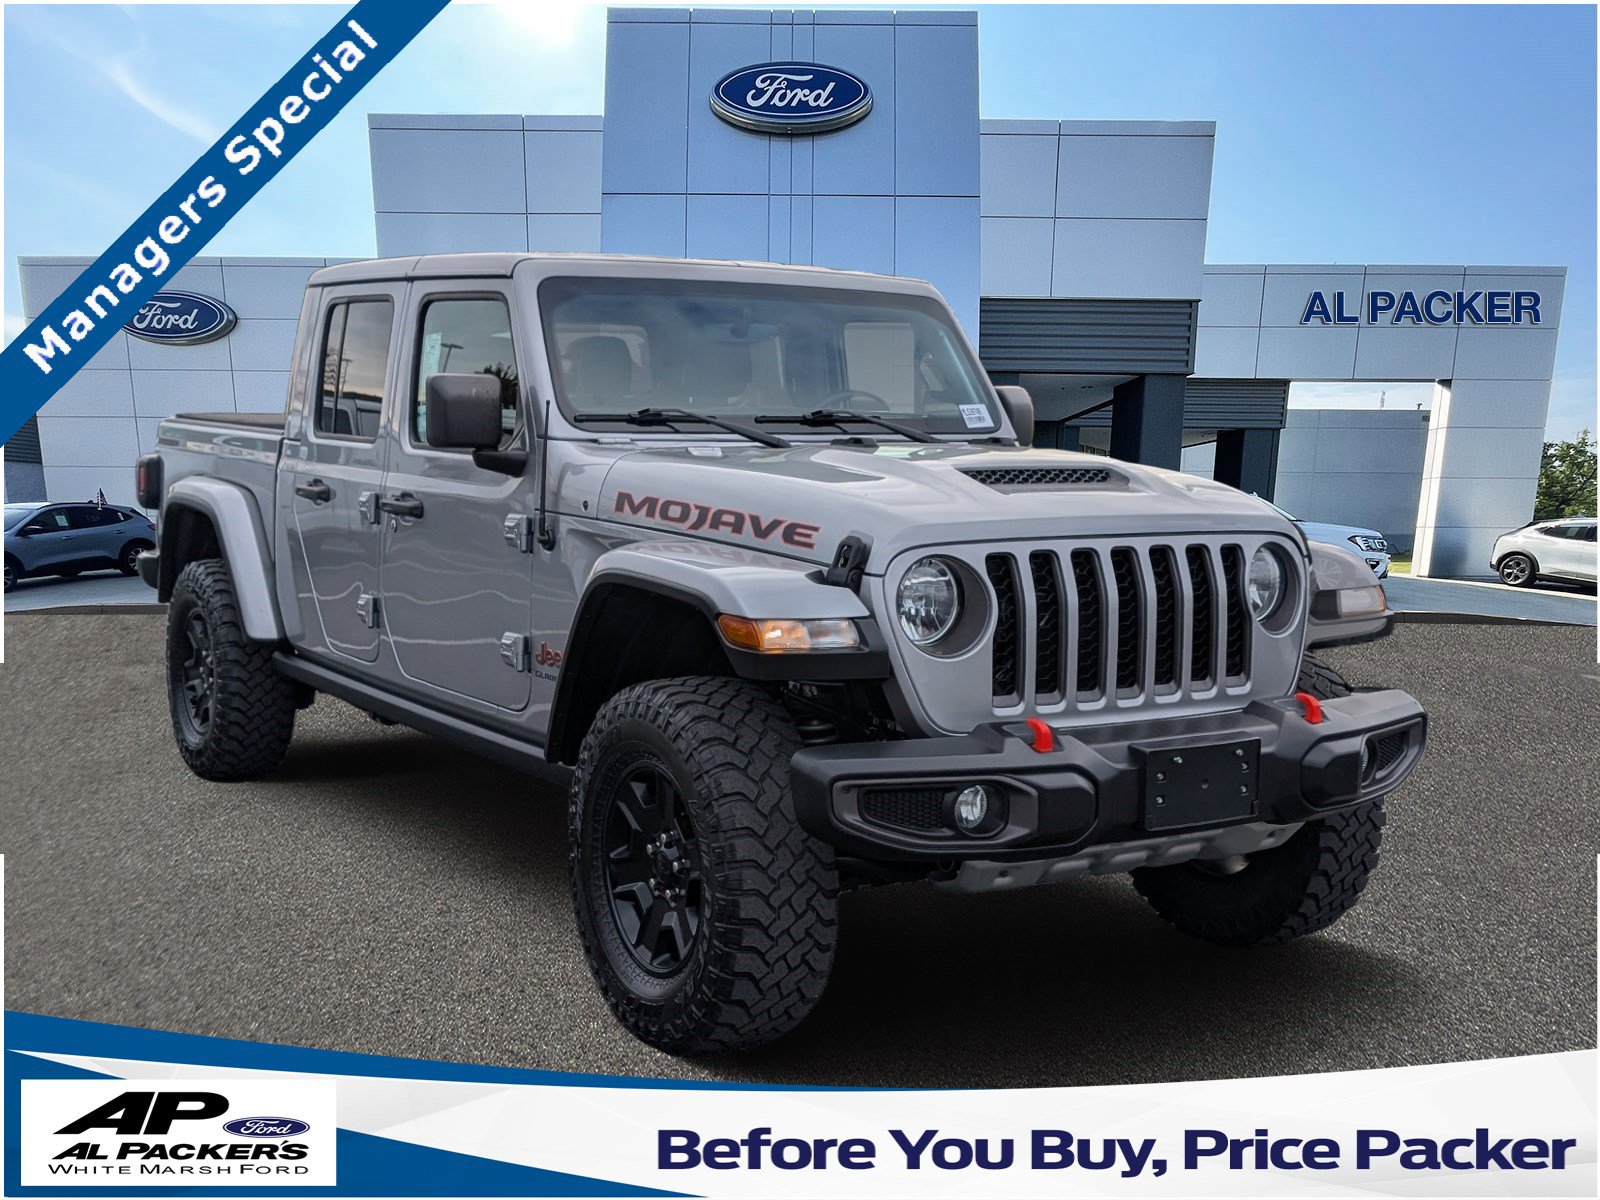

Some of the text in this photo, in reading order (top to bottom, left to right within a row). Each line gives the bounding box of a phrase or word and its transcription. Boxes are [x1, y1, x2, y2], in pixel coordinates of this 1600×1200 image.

[746, 73, 836, 107] Ford
[132, 301, 199, 329] Ford
[1302, 290, 1542, 325] AL PACKER
[614, 491, 822, 549] MOJAVE
